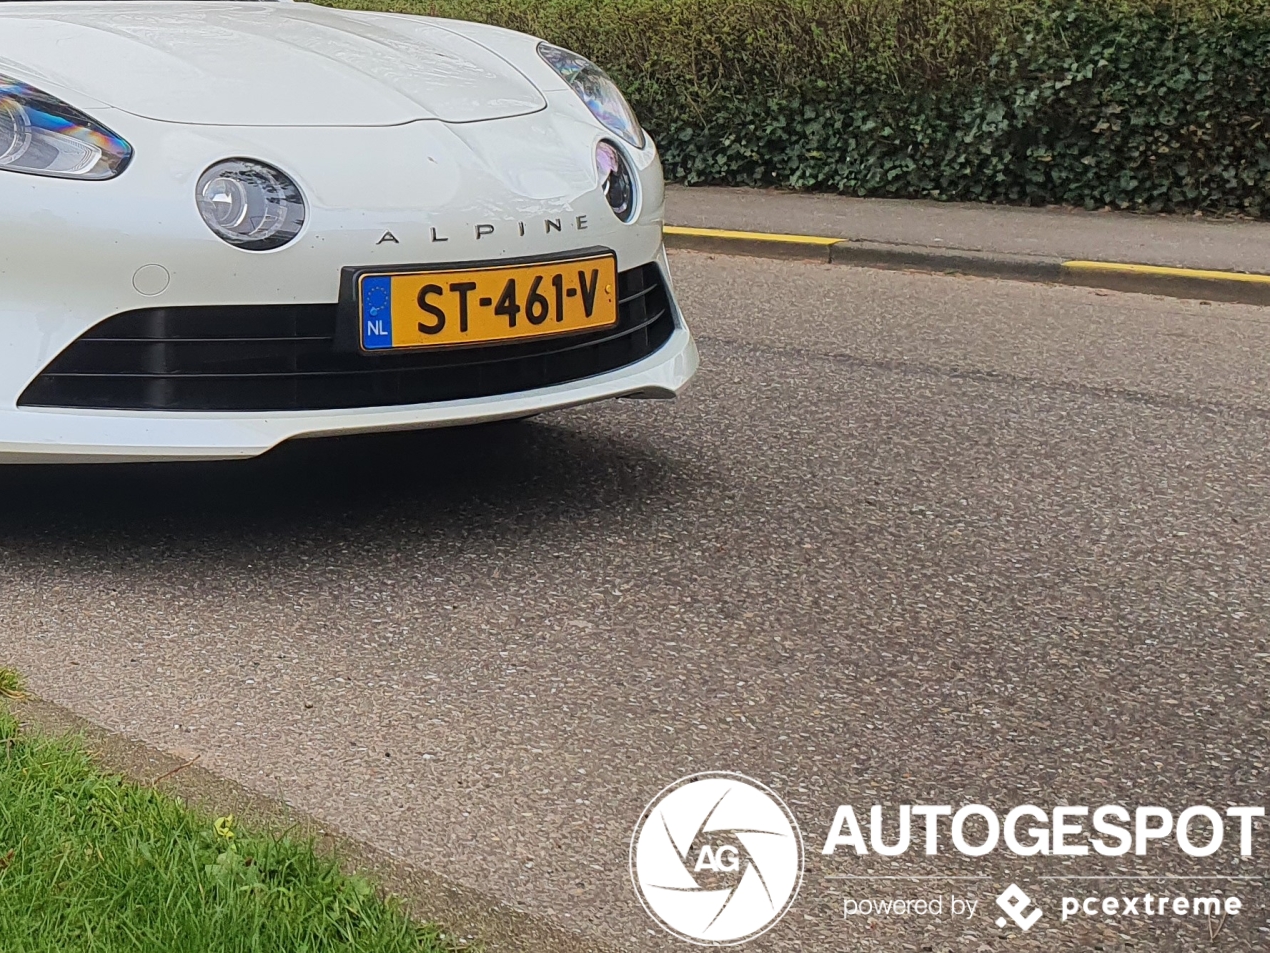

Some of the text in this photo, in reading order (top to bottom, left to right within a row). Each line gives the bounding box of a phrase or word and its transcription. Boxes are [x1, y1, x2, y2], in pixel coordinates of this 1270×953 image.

[376, 215, 588, 245] ALPINE
[367, 268, 598, 336] NL ST-461-V
